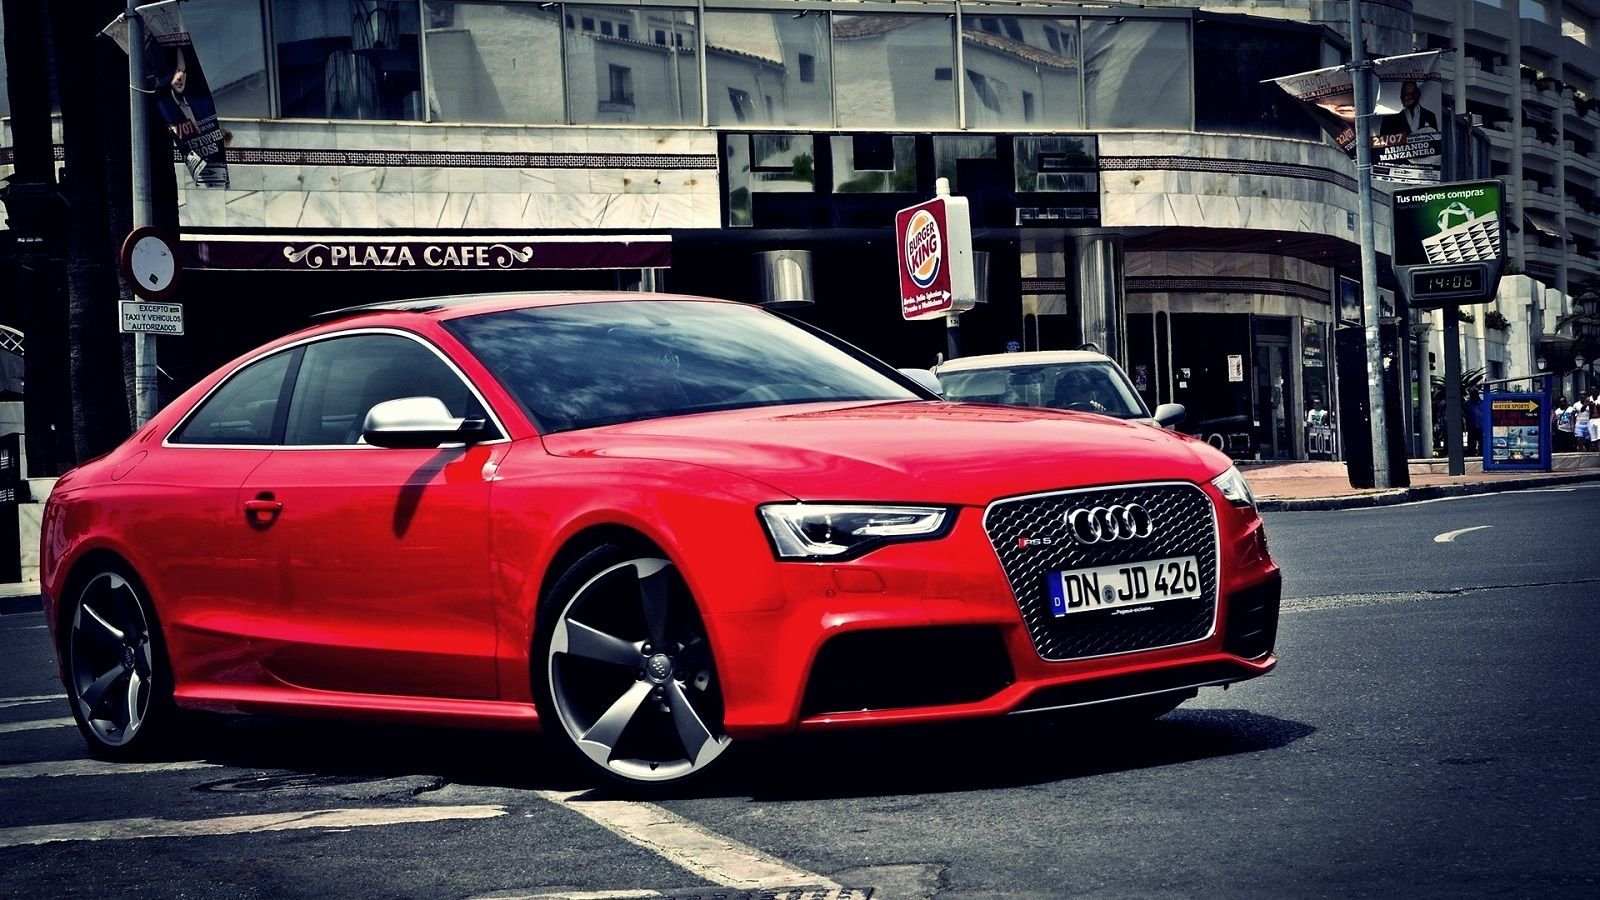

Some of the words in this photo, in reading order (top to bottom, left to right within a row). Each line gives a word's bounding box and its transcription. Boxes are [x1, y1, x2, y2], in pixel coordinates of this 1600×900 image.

[1373, 133, 1403, 146] 21/07
[1380, 148, 1435, 161] MANZANERO
[1384, 142, 1429, 155] ARMANDO
[1396, 195, 1410, 203] Tus
[1412, 191, 1446, 203] mejores
[1447, 188, 1484, 199] compras
[909, 221, 935, 255] BURGER
[330, 245, 416, 266] PLAZA
[423, 245, 490, 266] CAFE
[911, 233, 937, 275] KING
[1429, 275, 1472, 290] 14:06
[139, 305, 168, 313] EXCEPTO
[148, 315, 181, 323] VEHICULOS
[132, 324, 177, 332] AUTORIZADOS
[1064, 571, 1101, 609] DN
[1117, 566, 1149, 602] JD
[1154, 560, 1197, 597] 426
[1054, 597, 1061, 607] D
